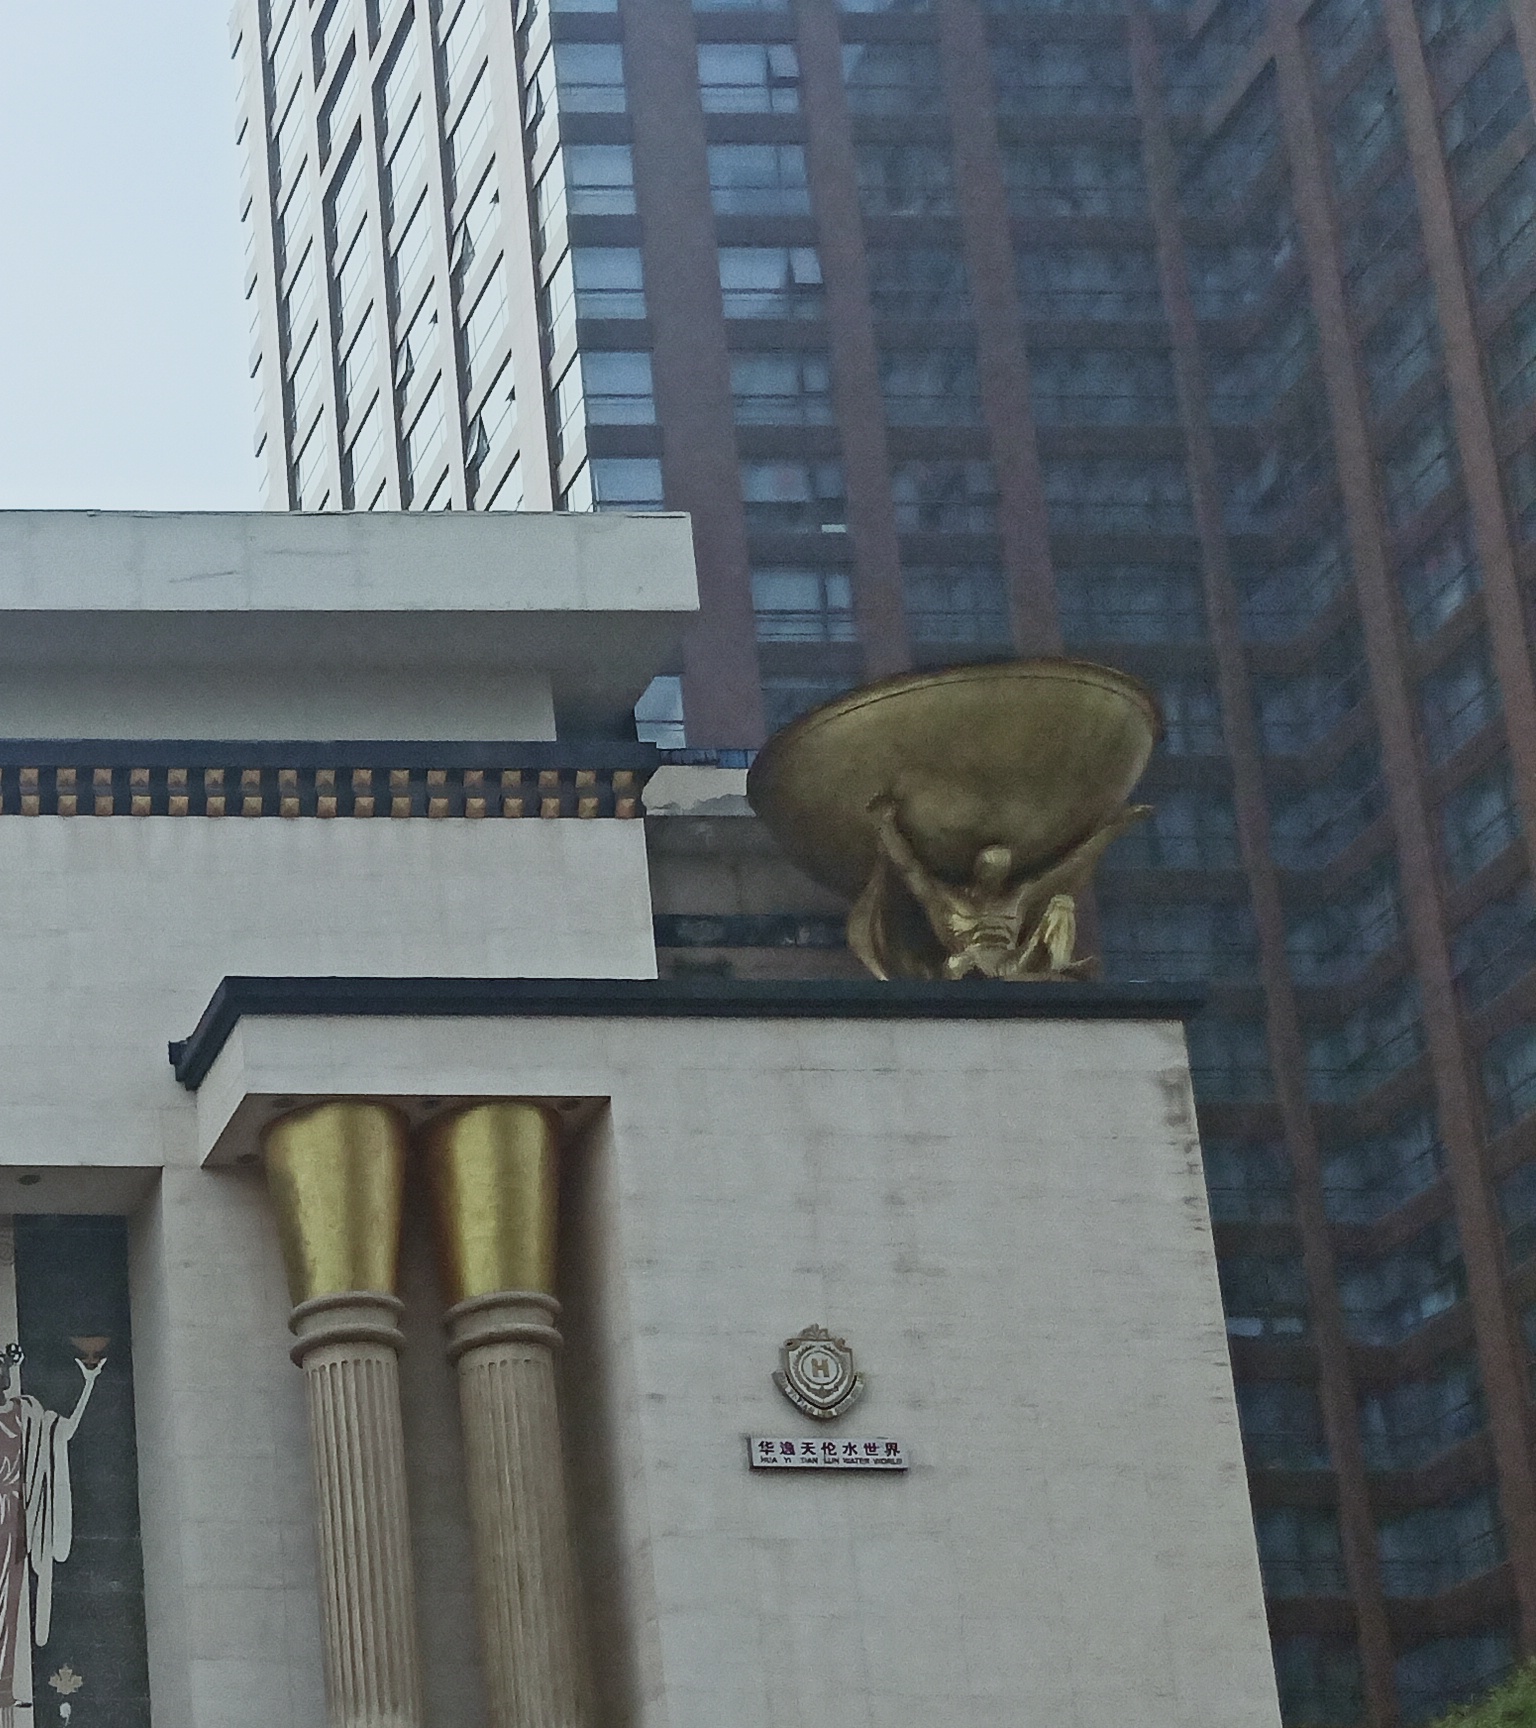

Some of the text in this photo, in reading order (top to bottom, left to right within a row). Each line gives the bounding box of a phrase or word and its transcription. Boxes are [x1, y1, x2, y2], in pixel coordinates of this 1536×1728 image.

[811, 1358, 830, 1377] H
[758, 1441, 900, 1456] 华逸天伦水世界
